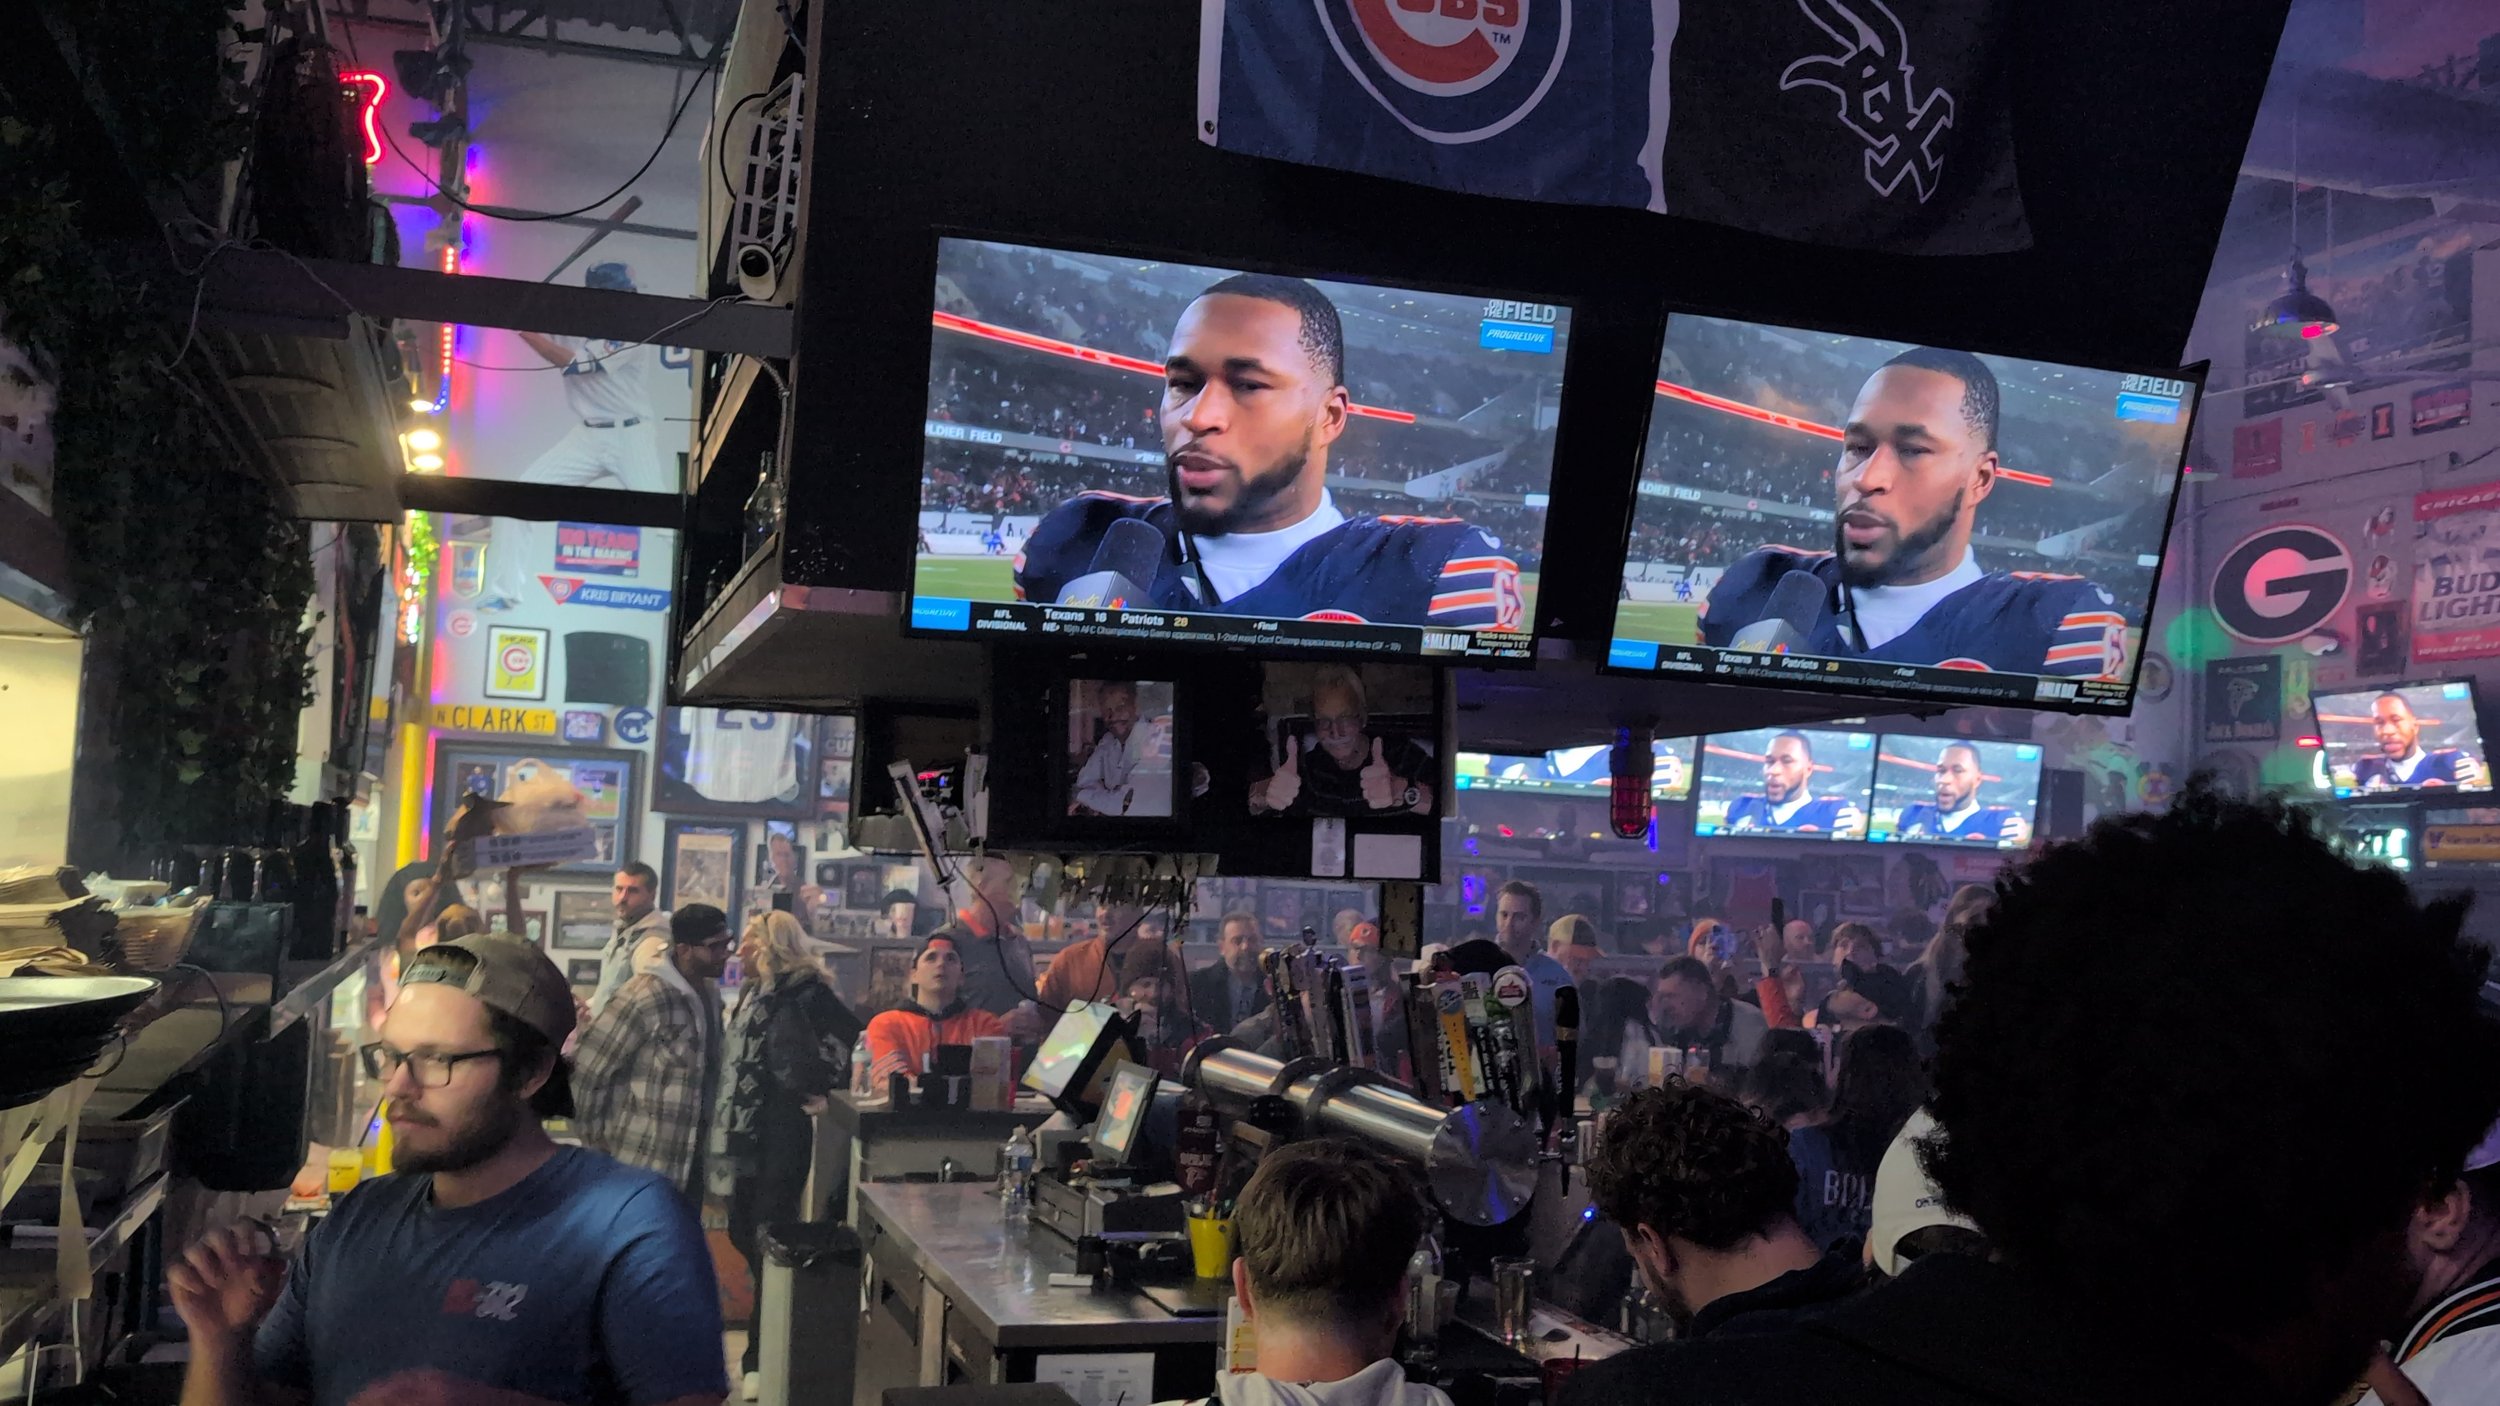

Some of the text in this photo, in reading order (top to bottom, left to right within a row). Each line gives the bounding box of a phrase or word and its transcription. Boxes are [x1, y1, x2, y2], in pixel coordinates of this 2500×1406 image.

[1492, 31, 1512, 45] TM
[1483, 306, 1503, 318] THE
[1502, 300, 1557, 324] FIELD
[1486, 328, 1546, 344] PROGRESSIVE
[2136, 375, 2185, 398] FIELD
[969, 428, 1002, 444] FIELD
[1673, 486, 1701, 501] FIELD
[2420, 491, 2500, 511] CHICAG
[575, 546, 592, 558] THE
[593, 547, 633, 562] MAKING
[2432, 571, 2500, 598] BUD
[581, 587, 662, 606] KRIS BRYANT
[993, 608, 1012, 620] NFL
[1044, 608, 1188, 628] Texans 16 Patriots 28
[976, 619, 1028, 632] DIVISIONAL
[1097, 625, 1150, 639] Championship
[1257, 621, 1278, 631] Final
[1431, 632, 1471, 651] MLK DAY
[1718, 652, 1753, 666] Texans
[1781, 657, 1819, 671] Patriots
[436, 710, 445, 723] N
[452, 705, 527, 733] CLARK
